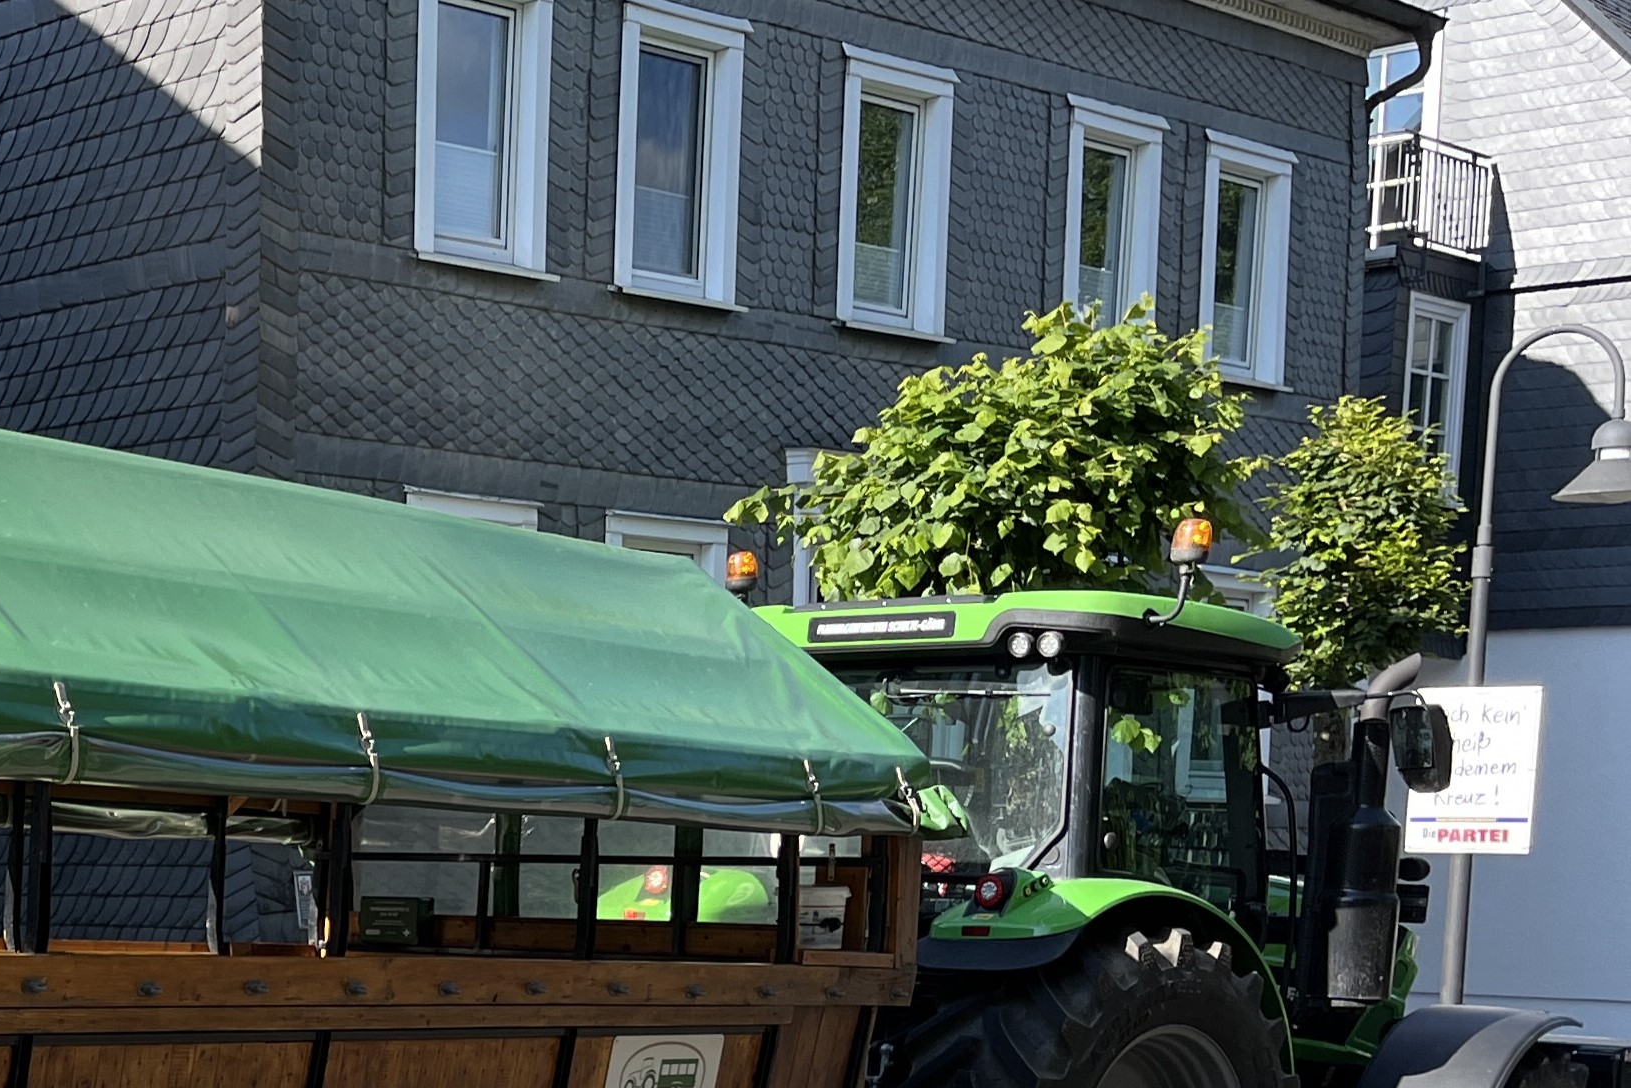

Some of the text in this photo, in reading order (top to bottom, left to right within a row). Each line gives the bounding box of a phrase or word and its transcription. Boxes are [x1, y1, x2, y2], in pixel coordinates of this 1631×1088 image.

[1454, 757, 1517, 777] deinem
[1422, 827, 1510, 843] Die PARTEI
